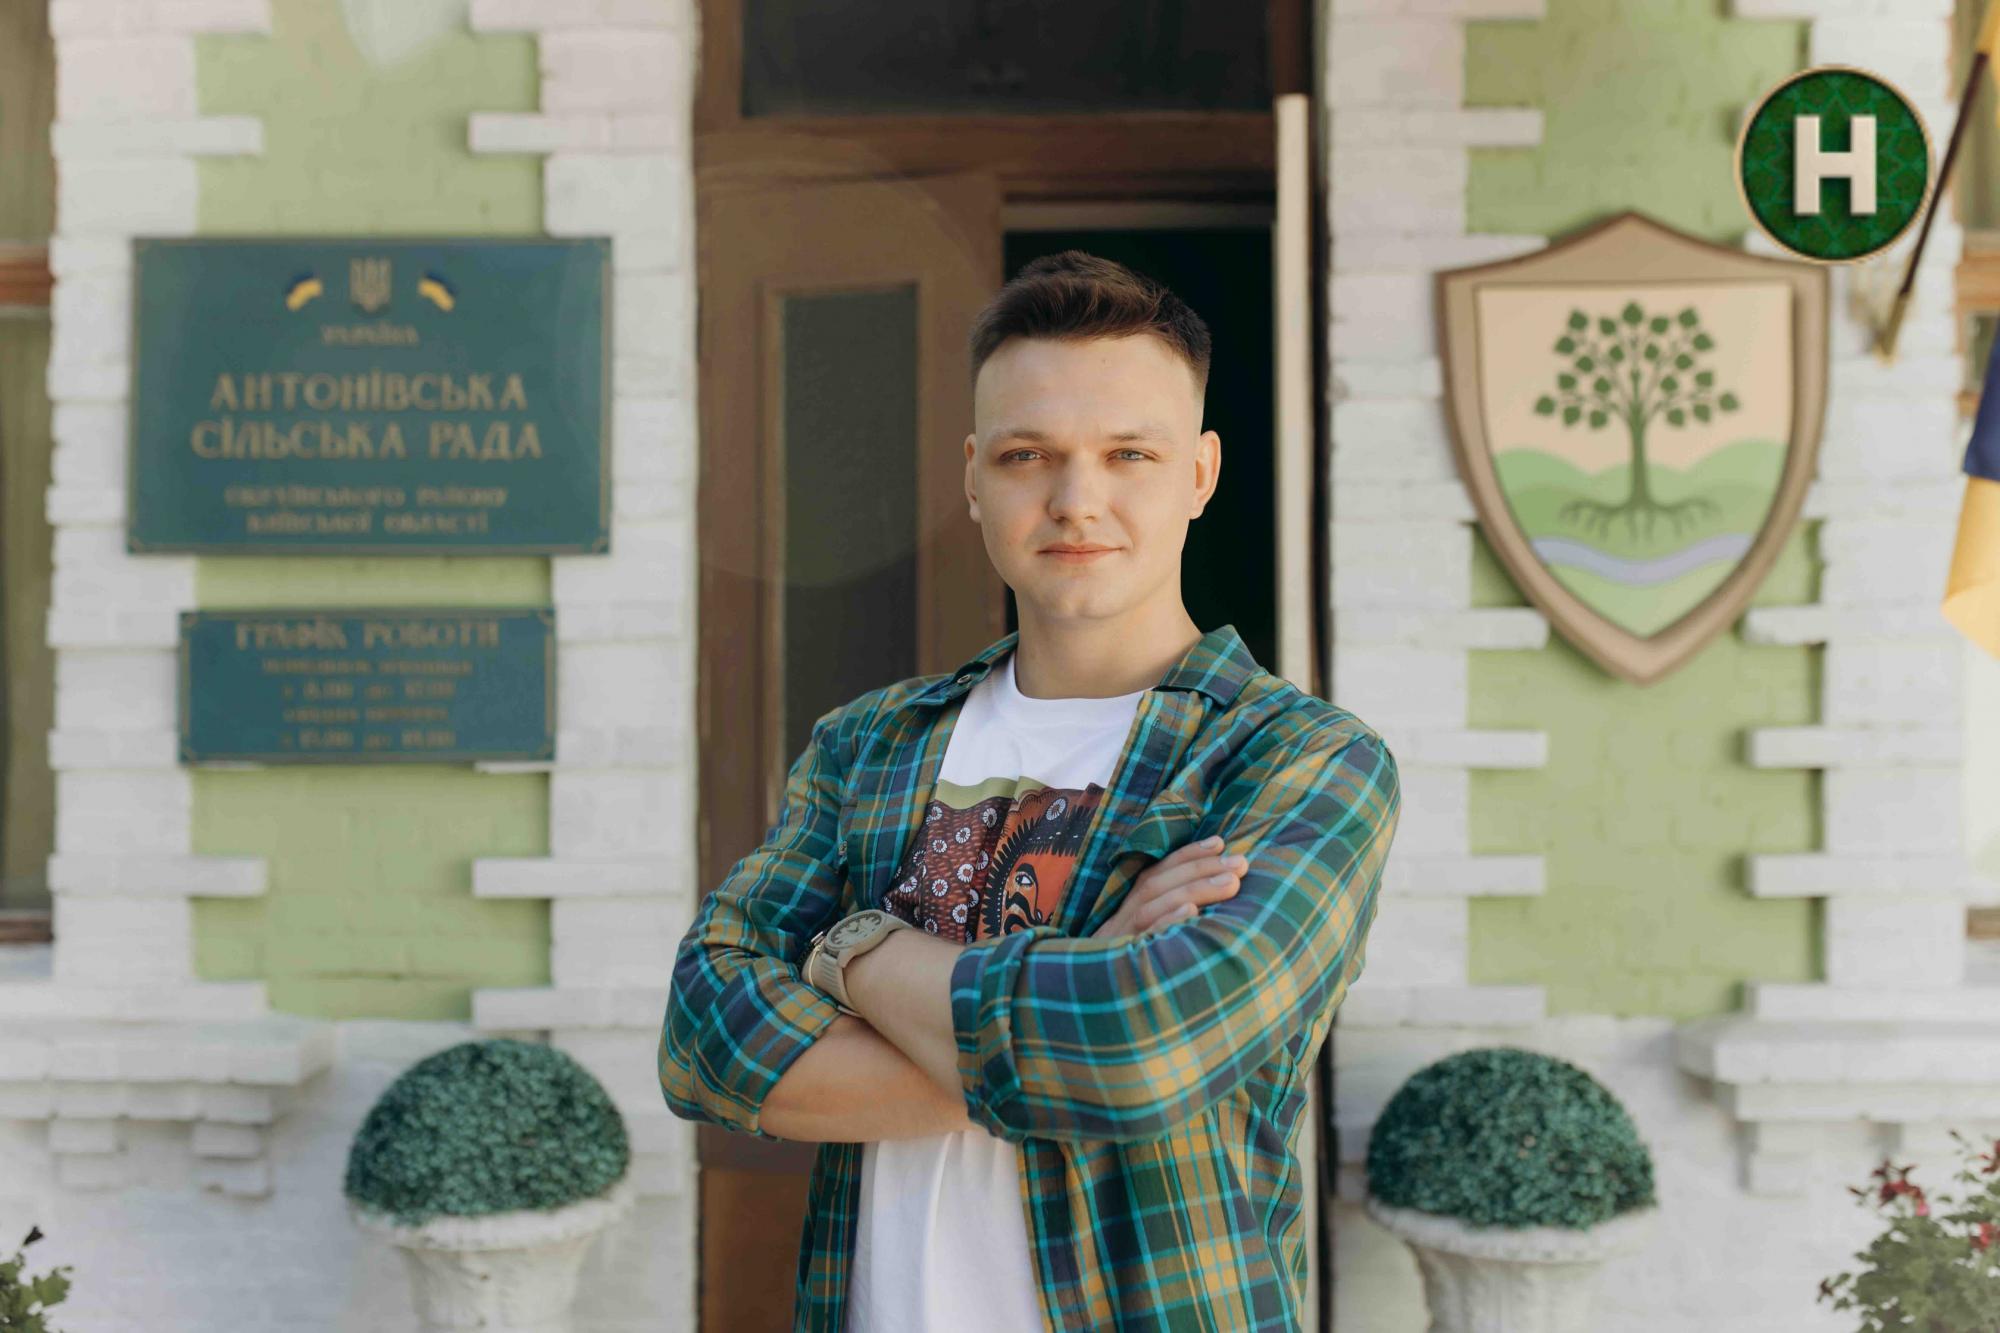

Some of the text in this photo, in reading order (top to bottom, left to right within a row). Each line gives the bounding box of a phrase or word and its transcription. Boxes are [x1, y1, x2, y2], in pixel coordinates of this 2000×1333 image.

[210, 369, 528, 411] АНТОНІВСЬКА
[191, 417, 543, 461] СІЛЬСЬКА РАДА
[363, 622, 499, 649] РОБОТИ
